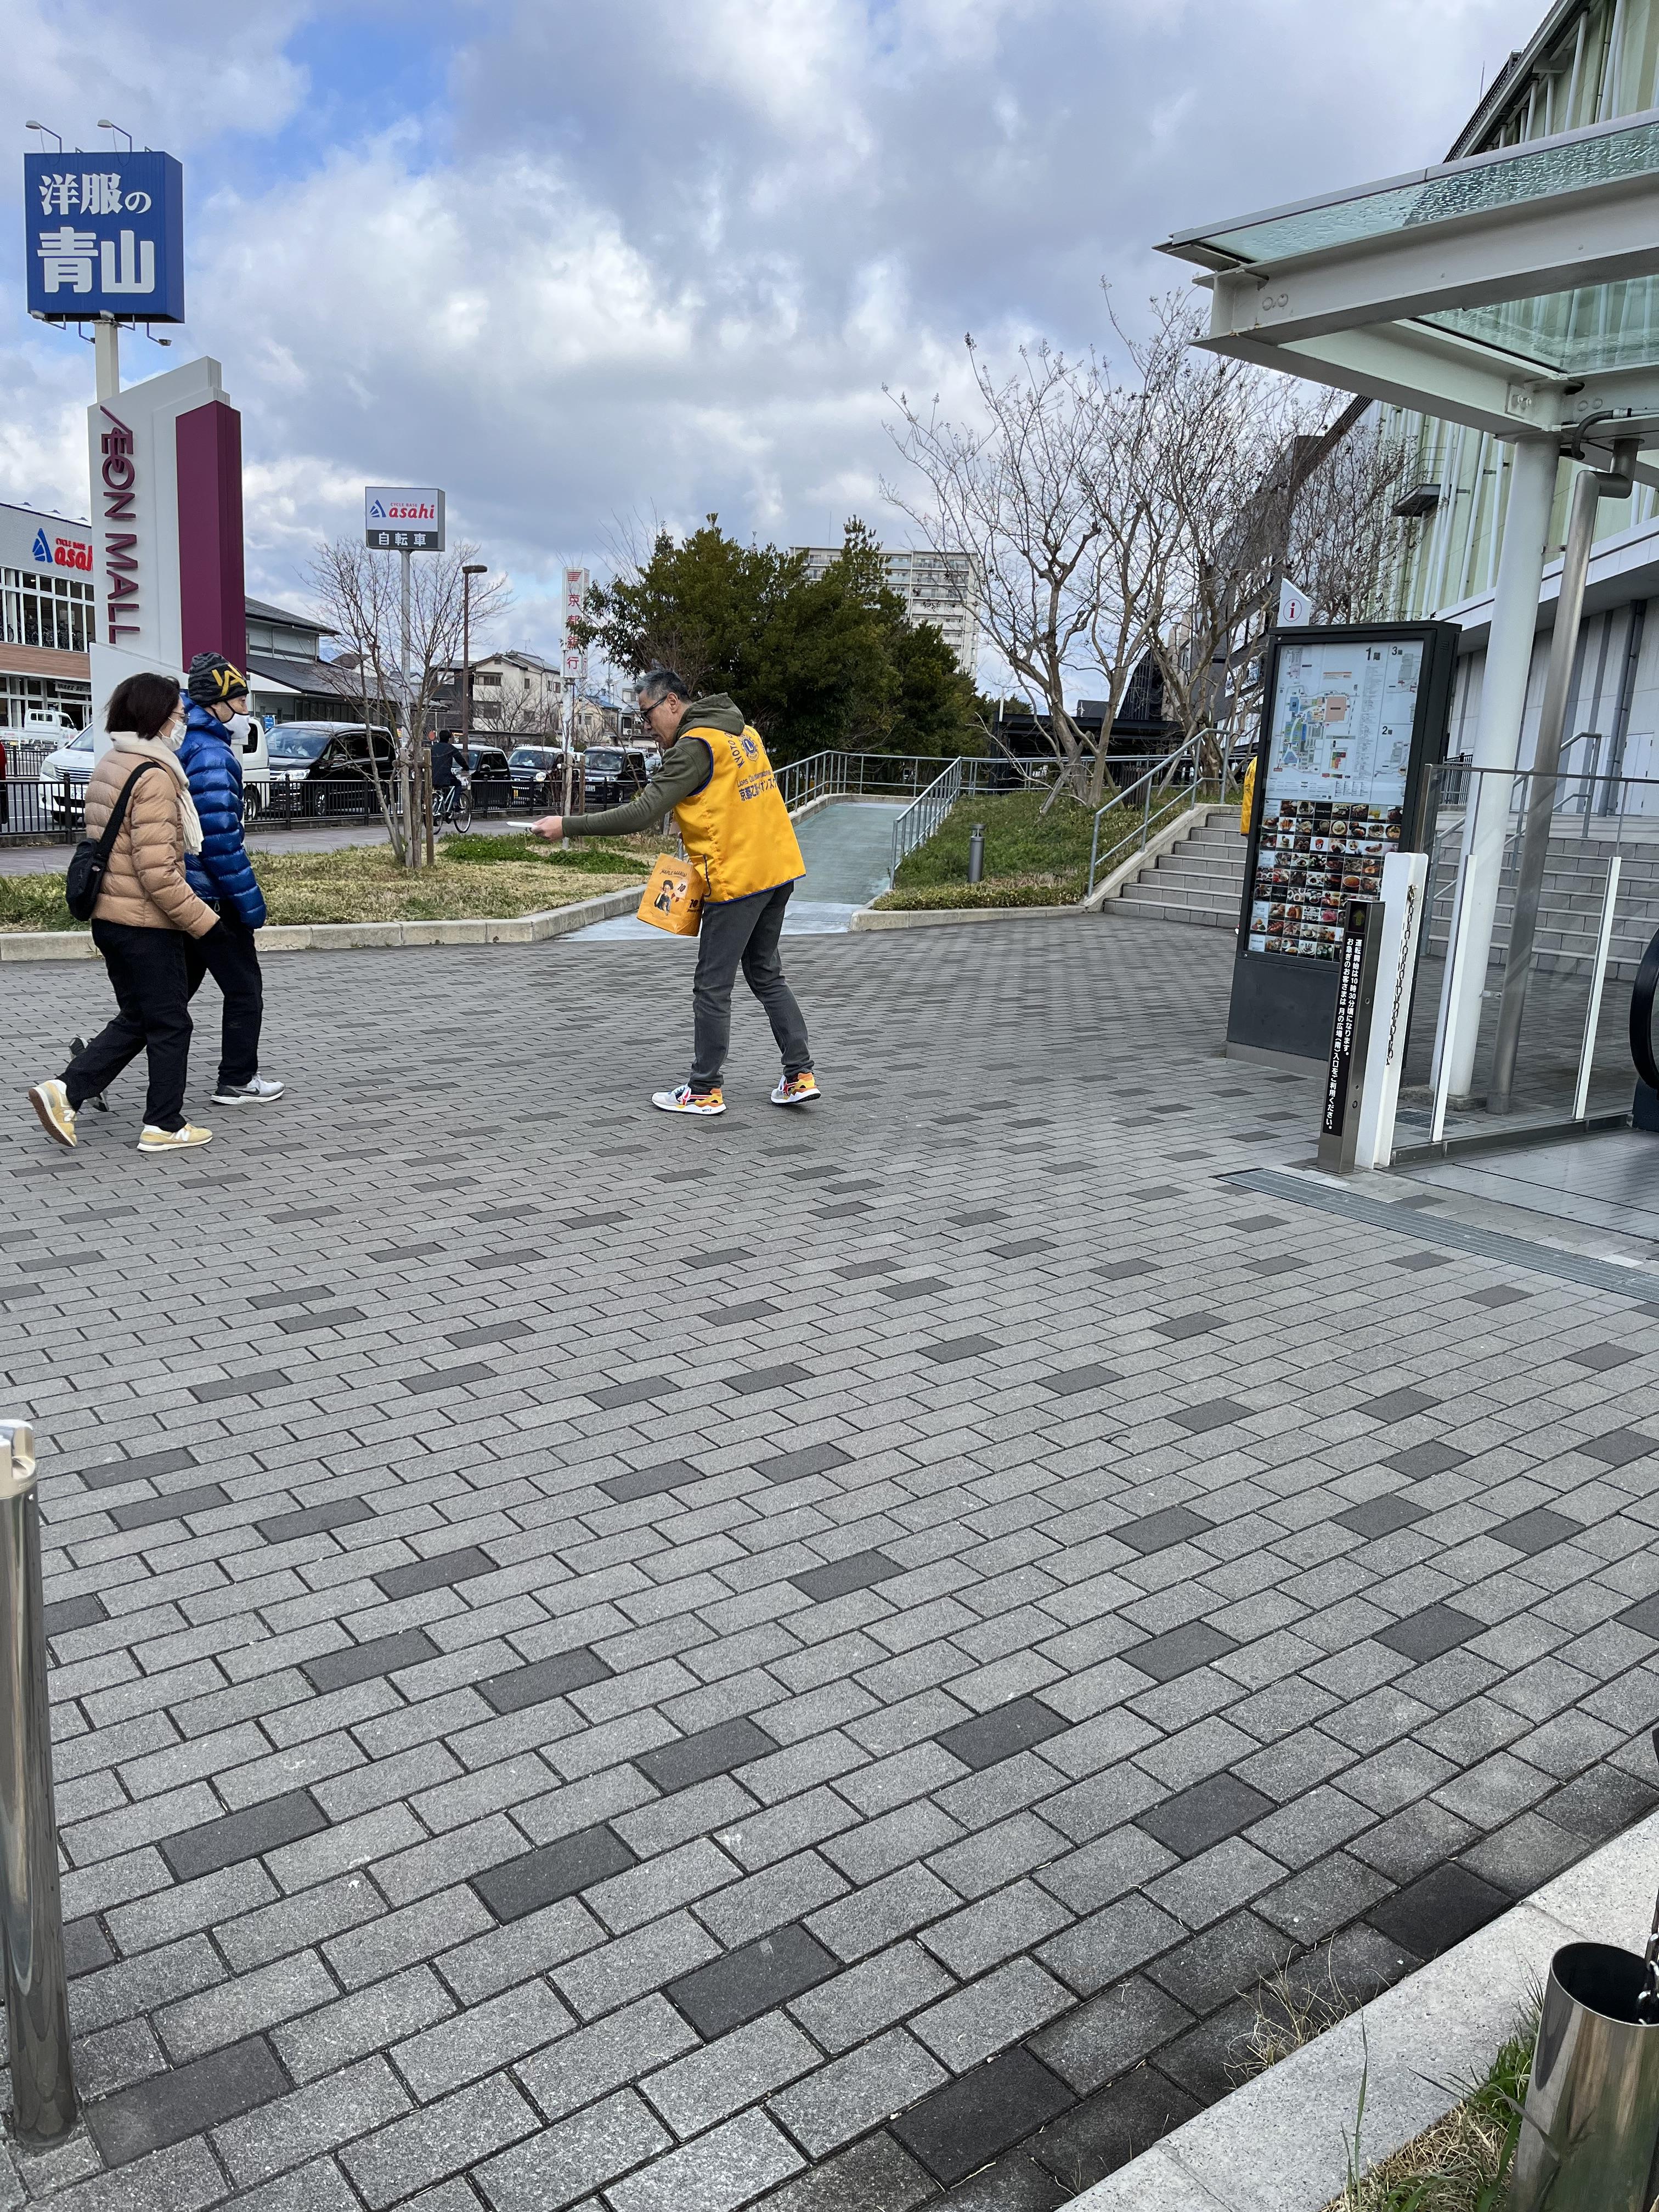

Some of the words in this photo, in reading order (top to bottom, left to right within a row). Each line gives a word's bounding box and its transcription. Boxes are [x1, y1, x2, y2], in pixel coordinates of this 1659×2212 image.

[39, 173, 151, 215] 洋服の
[37, 227, 155, 293] 青山
[389, 504, 435, 518] asahi
[379, 532, 426, 546] 自転車
[105, 533, 140, 644] MALL
[678, 883, 686, 892] 10
